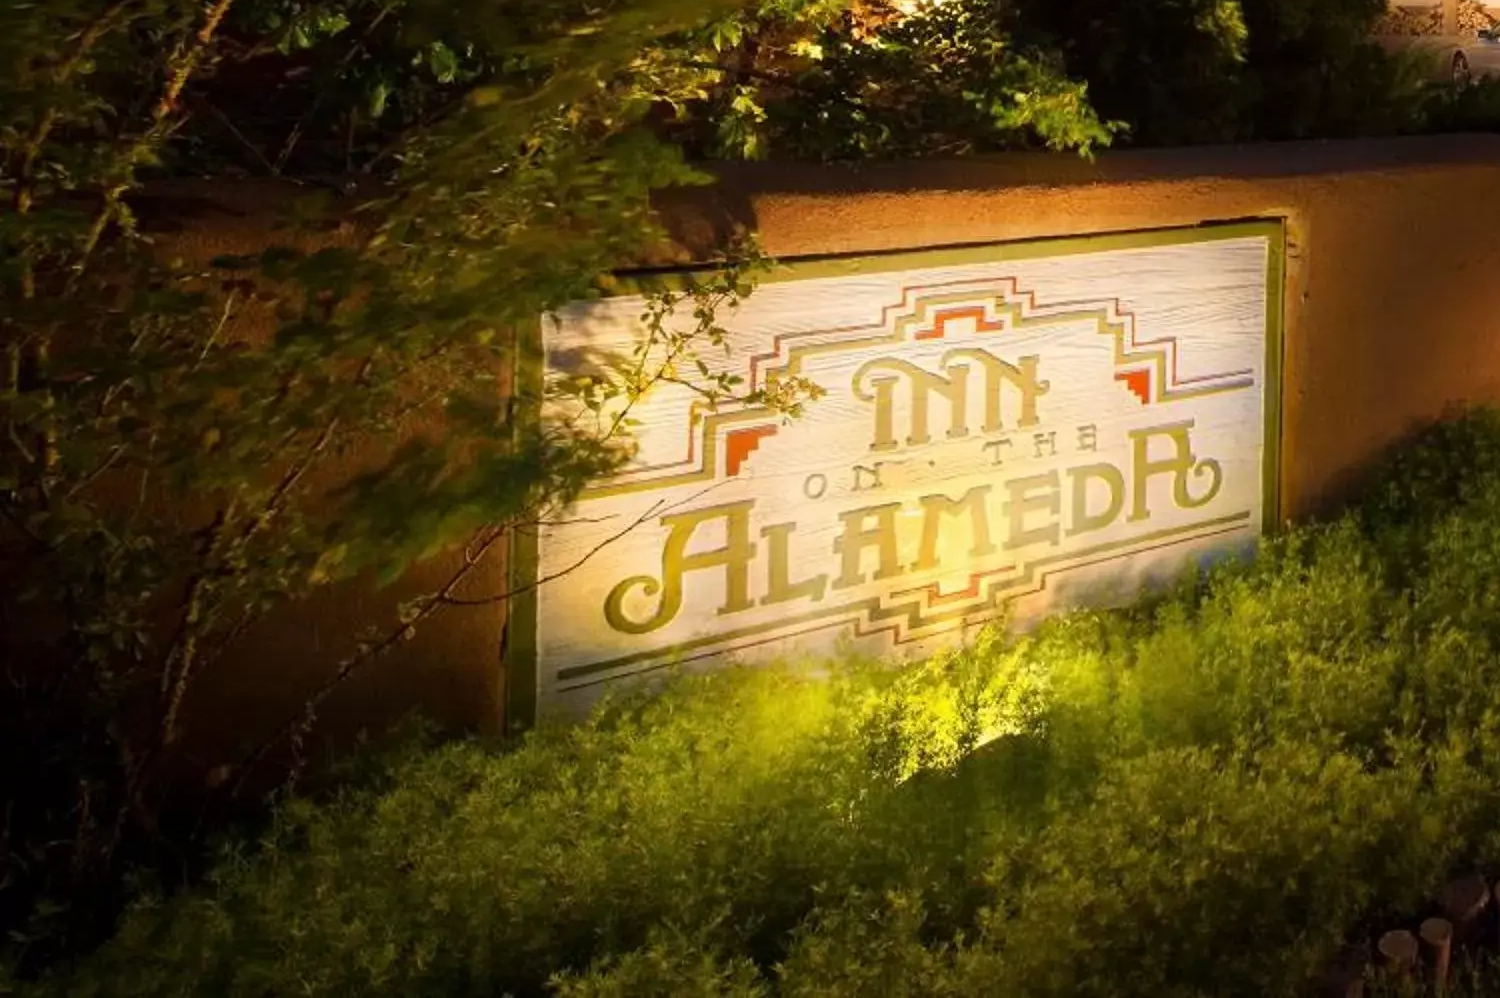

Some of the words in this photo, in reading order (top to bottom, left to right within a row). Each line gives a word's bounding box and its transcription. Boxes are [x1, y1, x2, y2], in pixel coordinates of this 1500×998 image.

[852, 348, 1050, 451] INN
[803, 462, 883, 499] ON
[982, 424, 1097, 466] THE
[604, 420, 1221, 634] ALAMEDA
